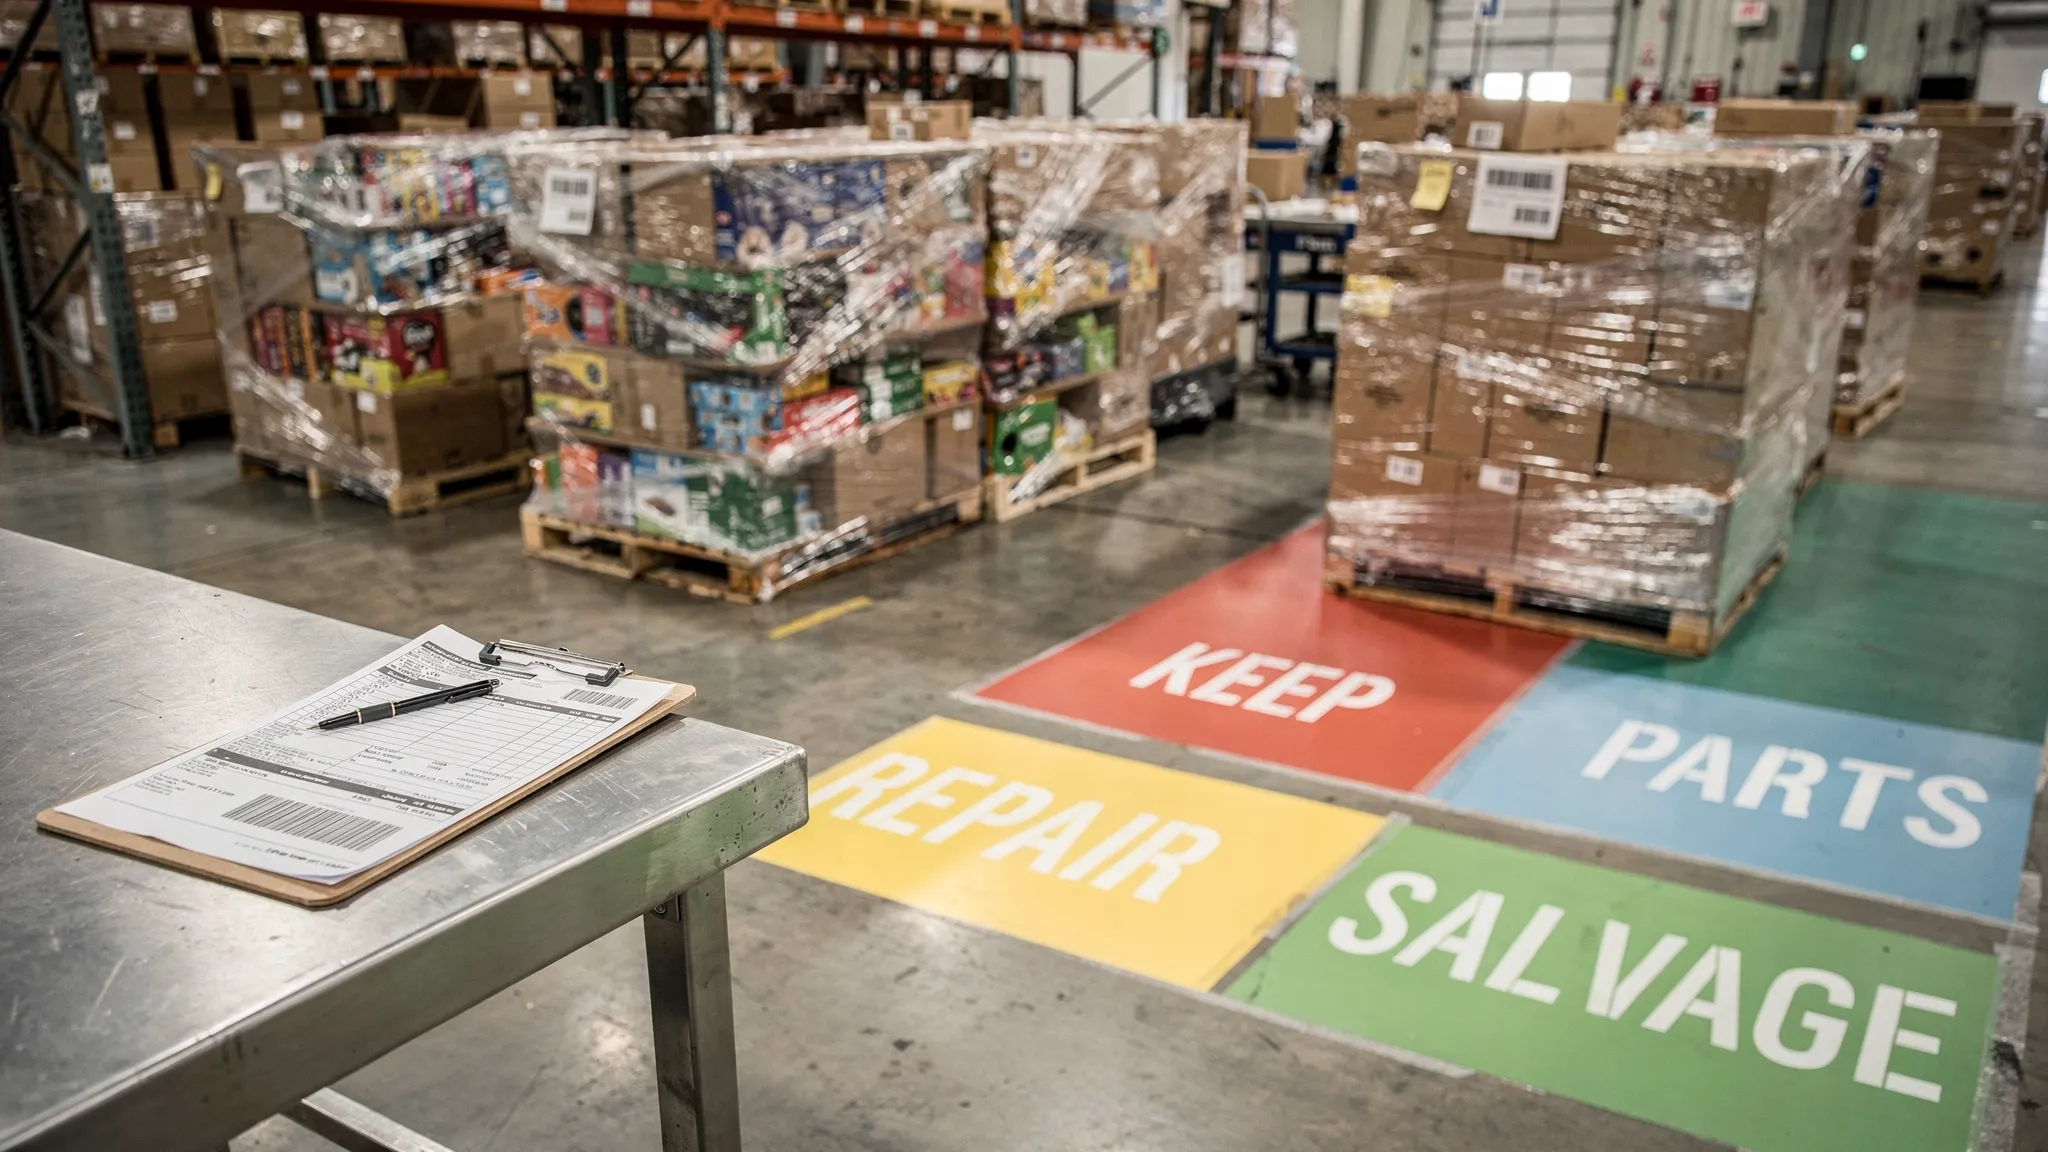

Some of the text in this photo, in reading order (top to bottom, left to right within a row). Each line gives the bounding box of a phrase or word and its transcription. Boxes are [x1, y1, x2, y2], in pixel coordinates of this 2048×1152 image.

[1130, 643, 1395, 723] KEEP
[808, 752, 1222, 903] REPAIR
[1582, 720, 1988, 850] PARTS
[1327, 872, 1957, 1102] SALVAGE
